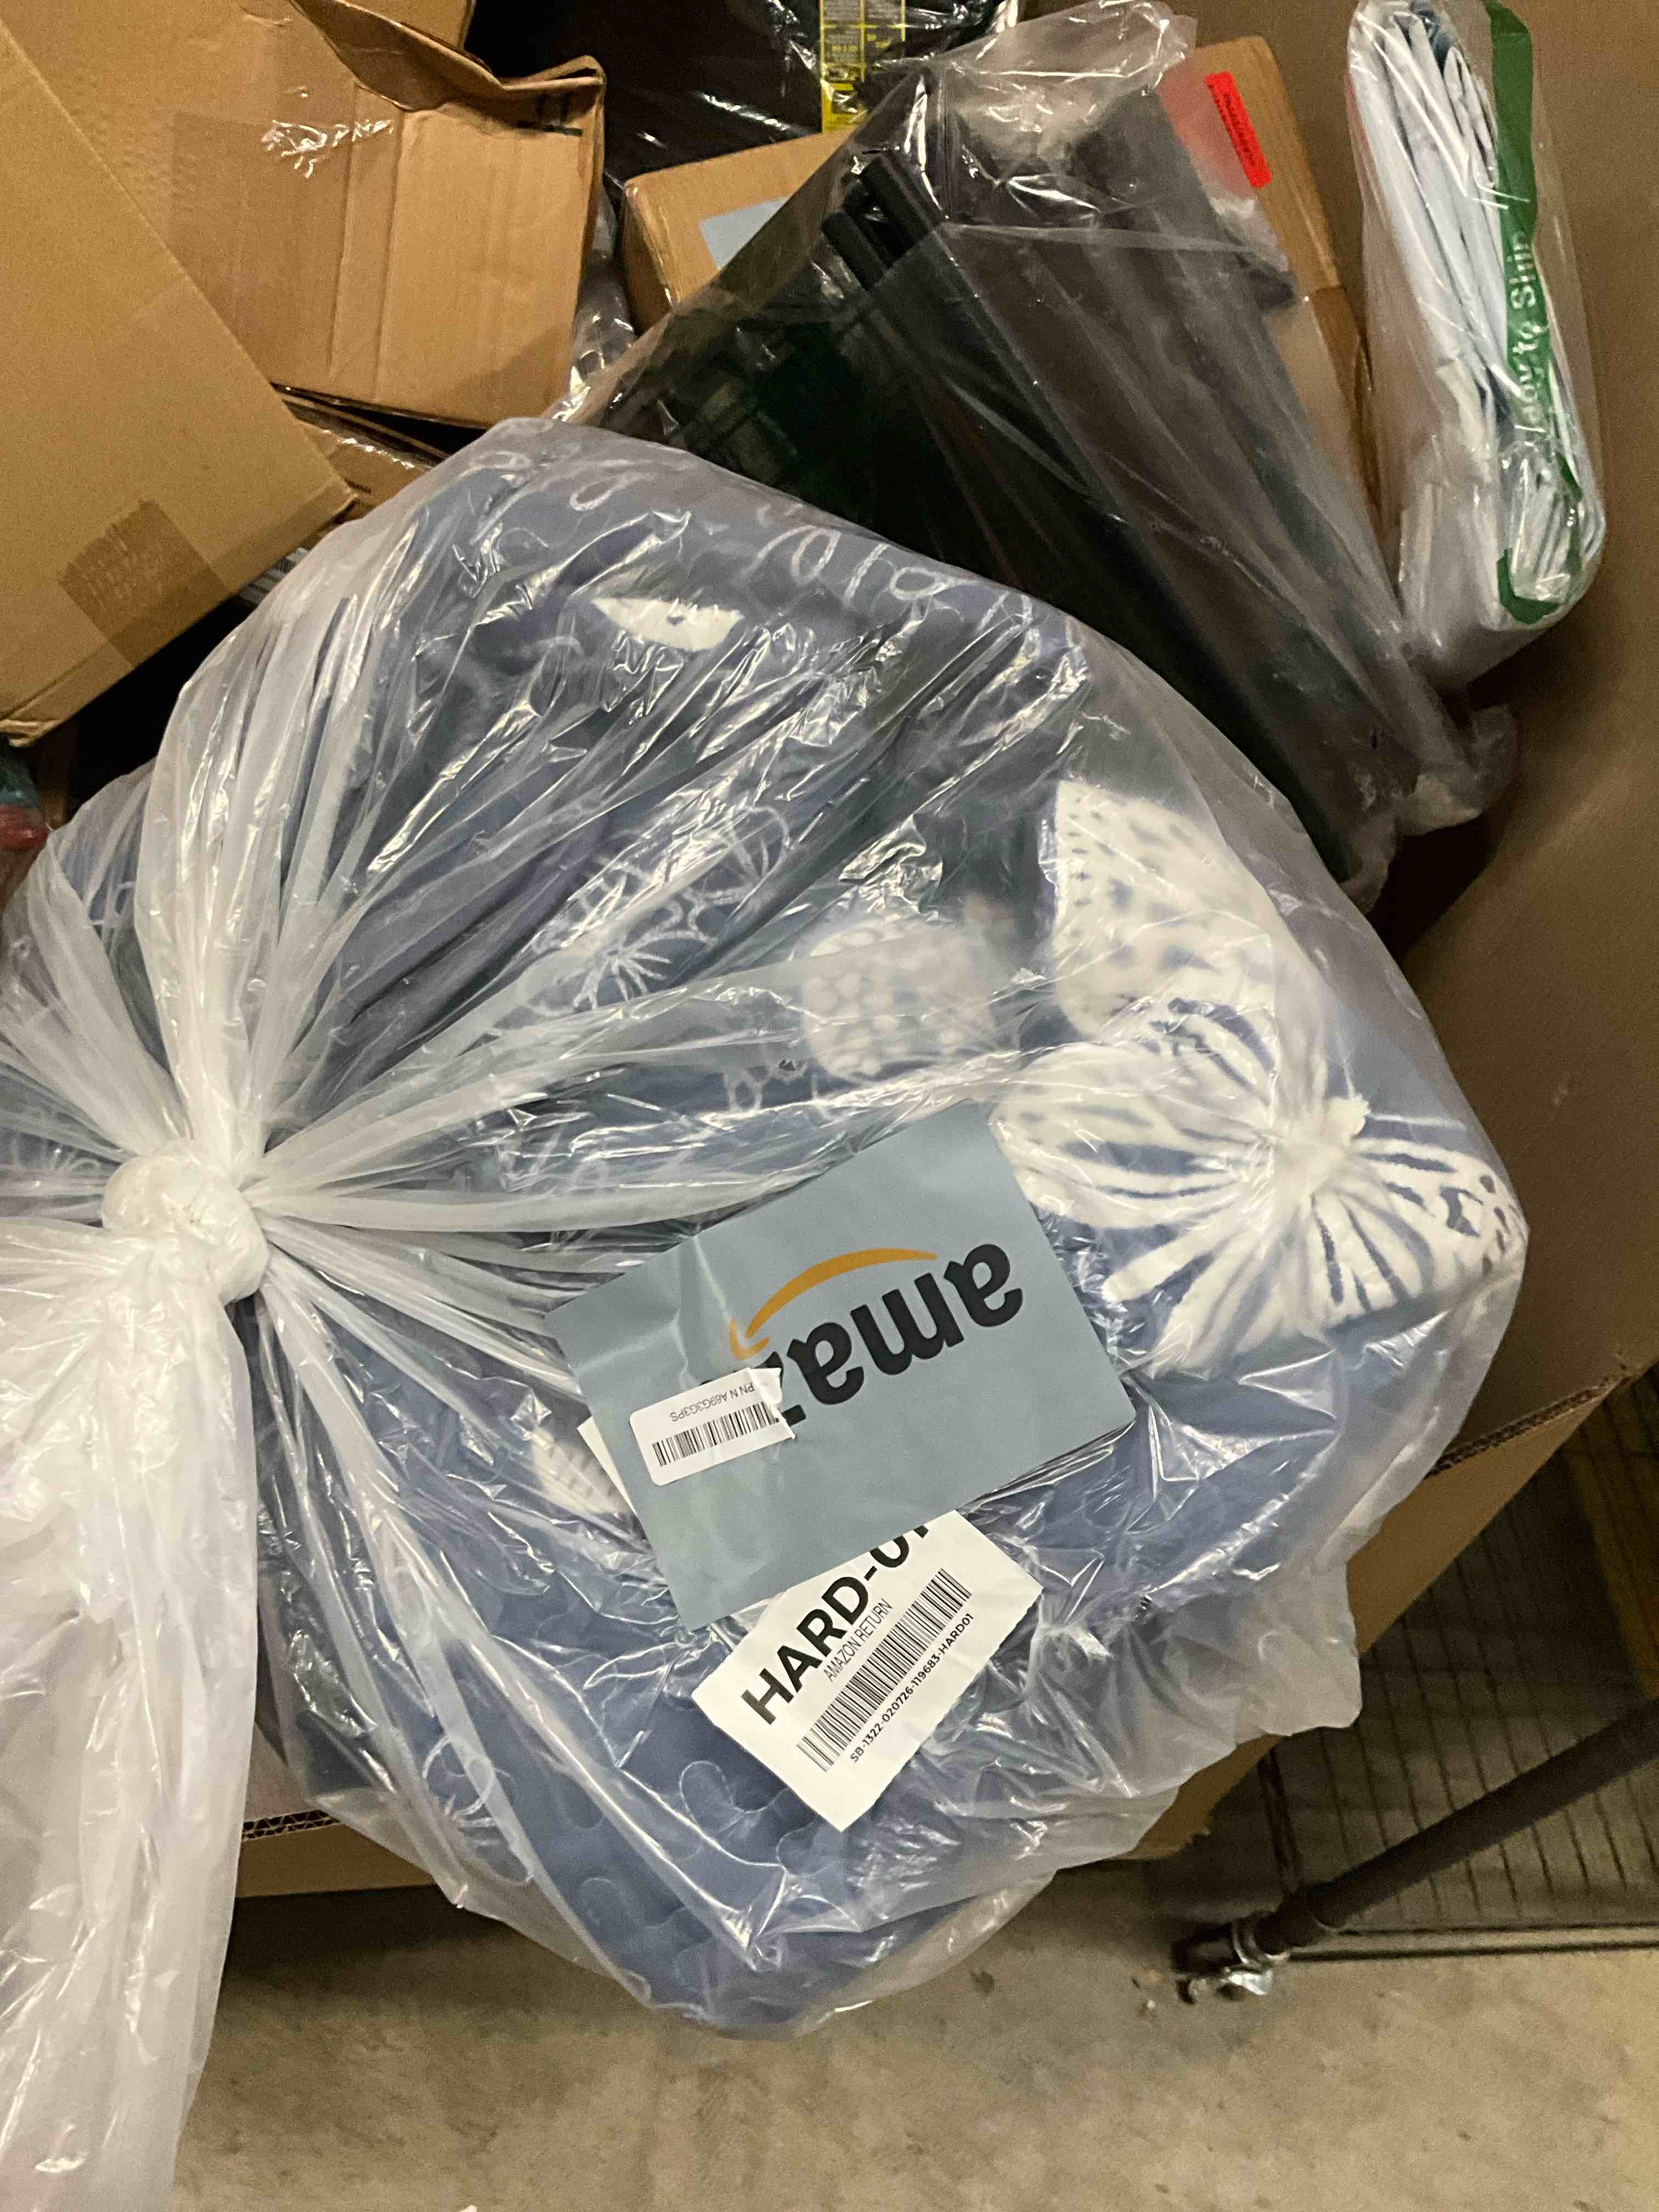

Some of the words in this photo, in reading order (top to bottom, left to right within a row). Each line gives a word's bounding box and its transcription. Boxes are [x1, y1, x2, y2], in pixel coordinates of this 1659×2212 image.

[823, 1637, 862, 1683] AMAZON
[854, 1598, 893, 1642] RETURN
[850, 1613, 974, 1763] SB-1322-020726-119683-HARD01
